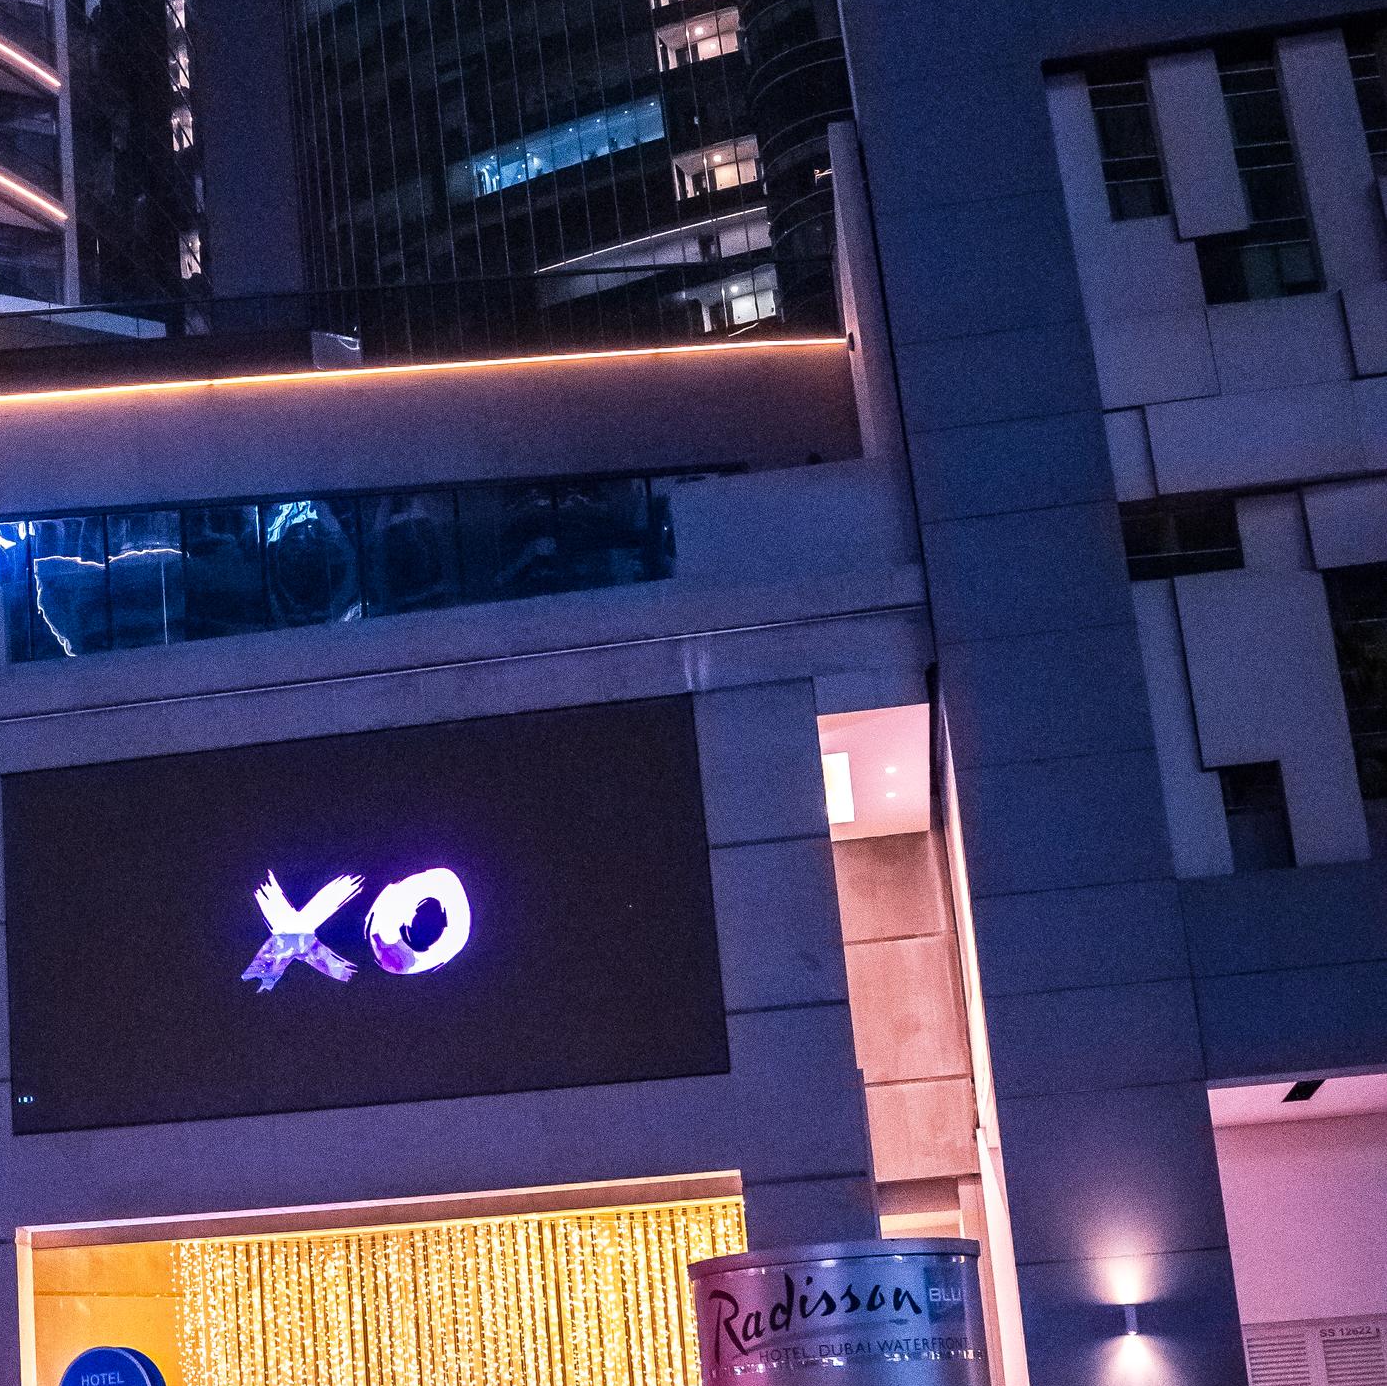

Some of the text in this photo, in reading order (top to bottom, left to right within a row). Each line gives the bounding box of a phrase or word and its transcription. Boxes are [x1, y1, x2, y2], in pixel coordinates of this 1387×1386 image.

[241, 867, 471, 993] XO
[708, 1273, 967, 1363] Radisson BLU
[818, 1341, 871, 1358] DUBAI
[876, 1336, 967, 1353] WATERFRONT
